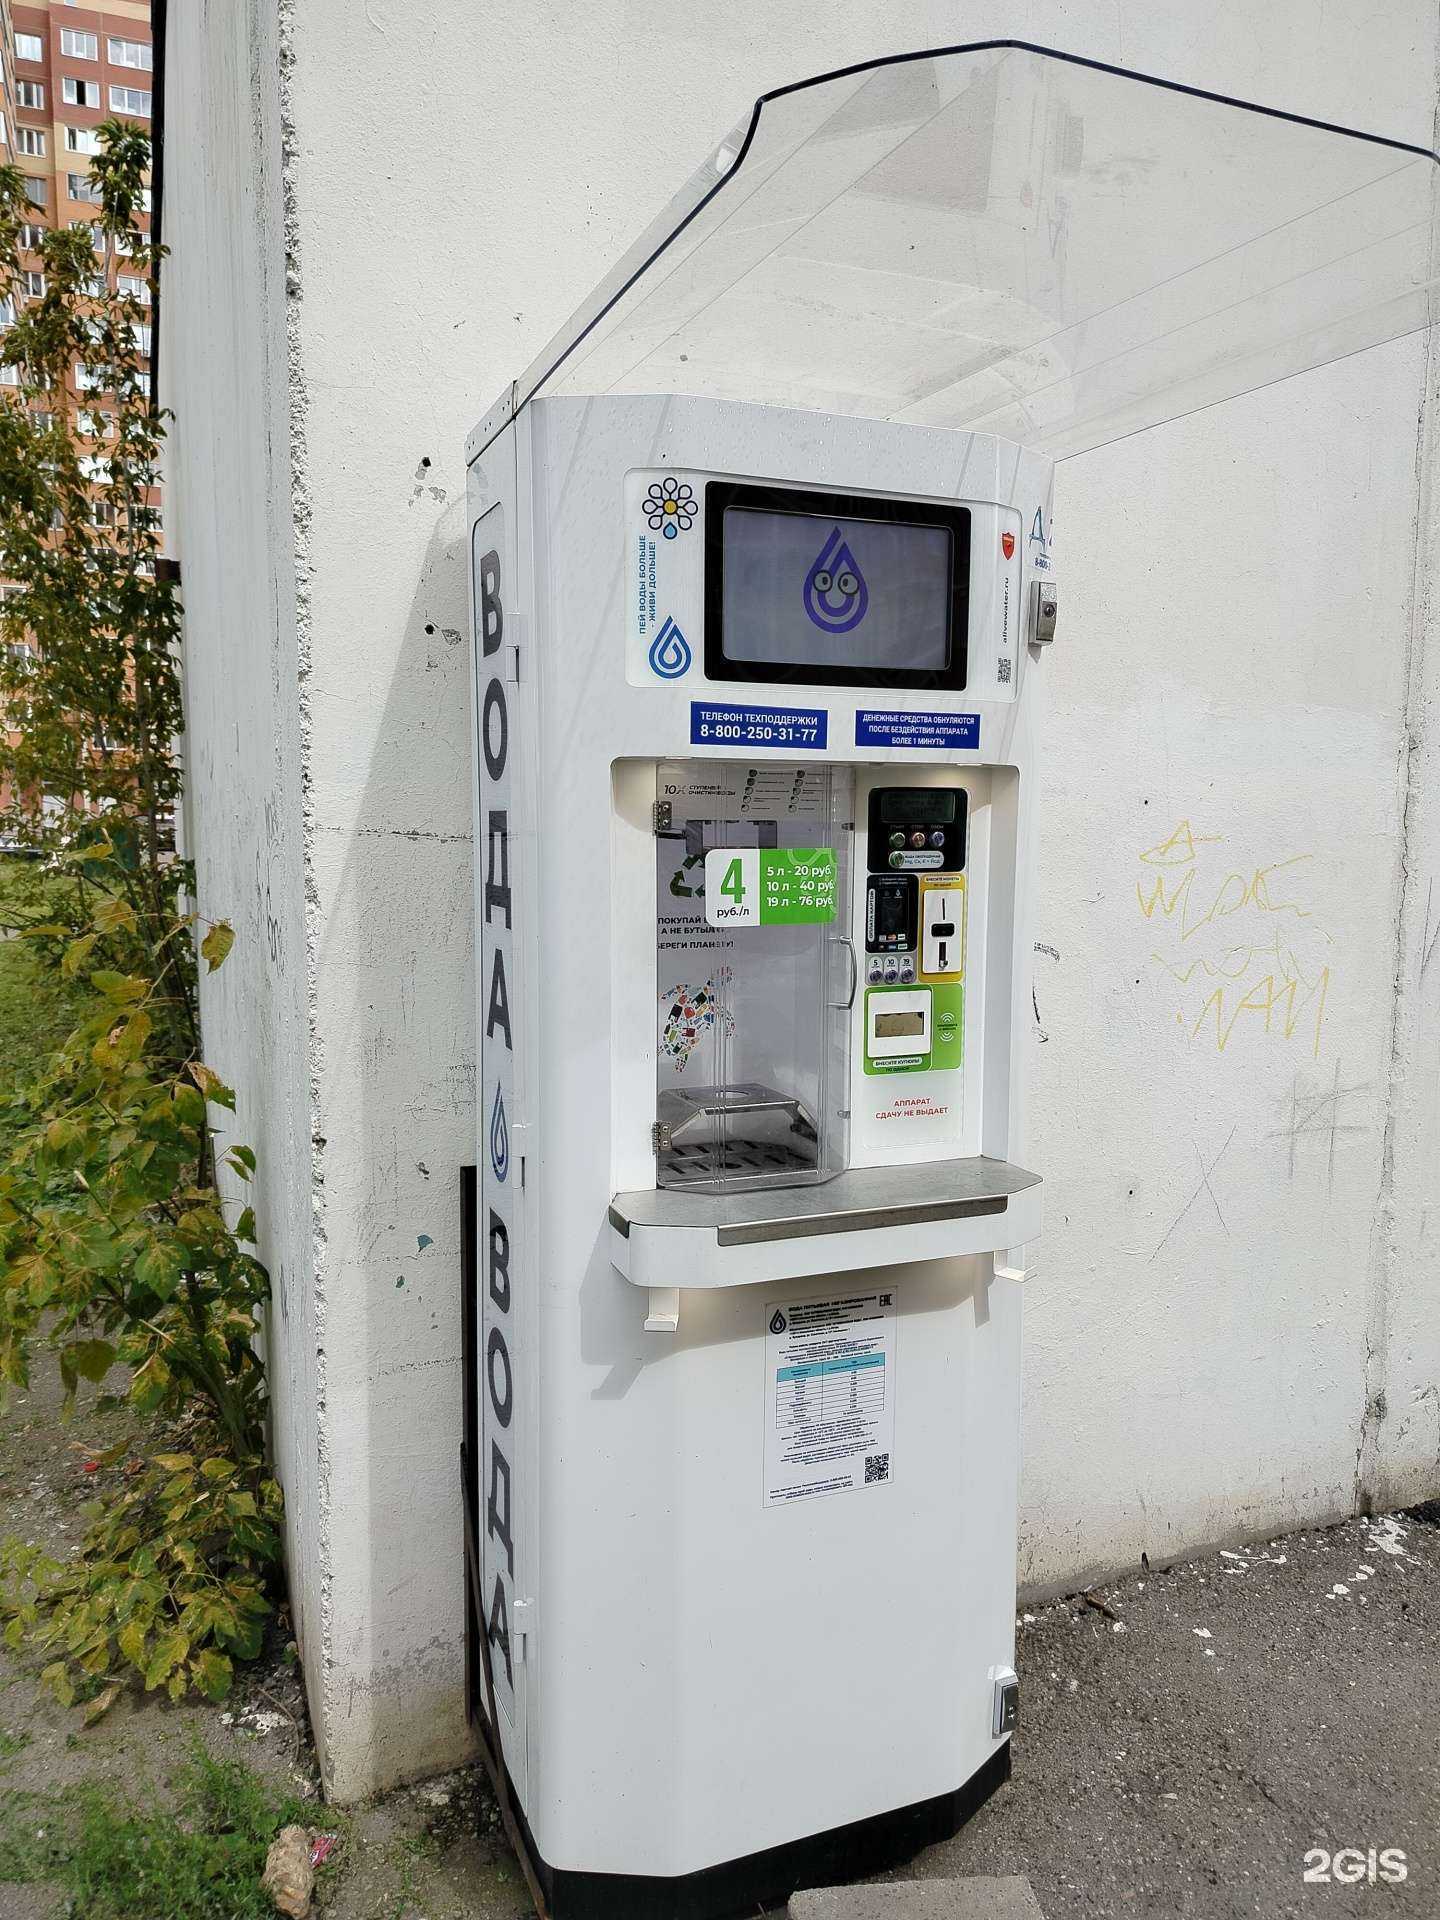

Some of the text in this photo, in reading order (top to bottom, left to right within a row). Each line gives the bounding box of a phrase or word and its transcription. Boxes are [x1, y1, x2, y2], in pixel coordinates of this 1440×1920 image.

[648, 541, 656, 589] ДОЛЬШЕ!
[638, 535, 647, 634] ПЕЙ ВОДЫ БОЛЬШЕ
[648, 591, 656, 622] ЖИВИ
[700, 711, 818, 726] ТЕЛЕФОН ТЕХПОДДЕРЖКИ
[863, 714, 975, 725] ДЕНЕЖНЫЕ СРЕДСТВА ОБНУЛЯЮТСЯ
[700, 724, 818, 742] 8-800-250-31-77
[868, 725, 968, 736] ПОСЛЕ БЕЗДЕЙСТВИЯ АППАРАТА
[891, 737, 945, 746] БОЛЕЕ 1 МИНУТЫ
[480, 549, 513, 1051] ВОДА
[767, 866, 775, 877] 5
[777, 867, 785, 876] л
[794, 865, 809, 876] 20
[720, 858, 747, 904] 4
[767, 881, 779, 891] 10
[782, 882, 790, 891] л
[799, 880, 815, 891] 40
[767, 896, 779, 907] 19
[781, 898, 789, 906] л
[799, 895, 814, 906] 76
[717, 906, 750, 918] руб./л
[657, 915, 702, 925] ПОКУПАЙ
[661, 927, 668, 935] А
[669, 927, 682, 935] НЕ
[894, 1098, 931, 1107] АППАРАТ
[875, 1107, 949, 1120] СДАЧУ НЕ ВЫДАЕТ
[487, 1206, 515, 1694] ВОДА
